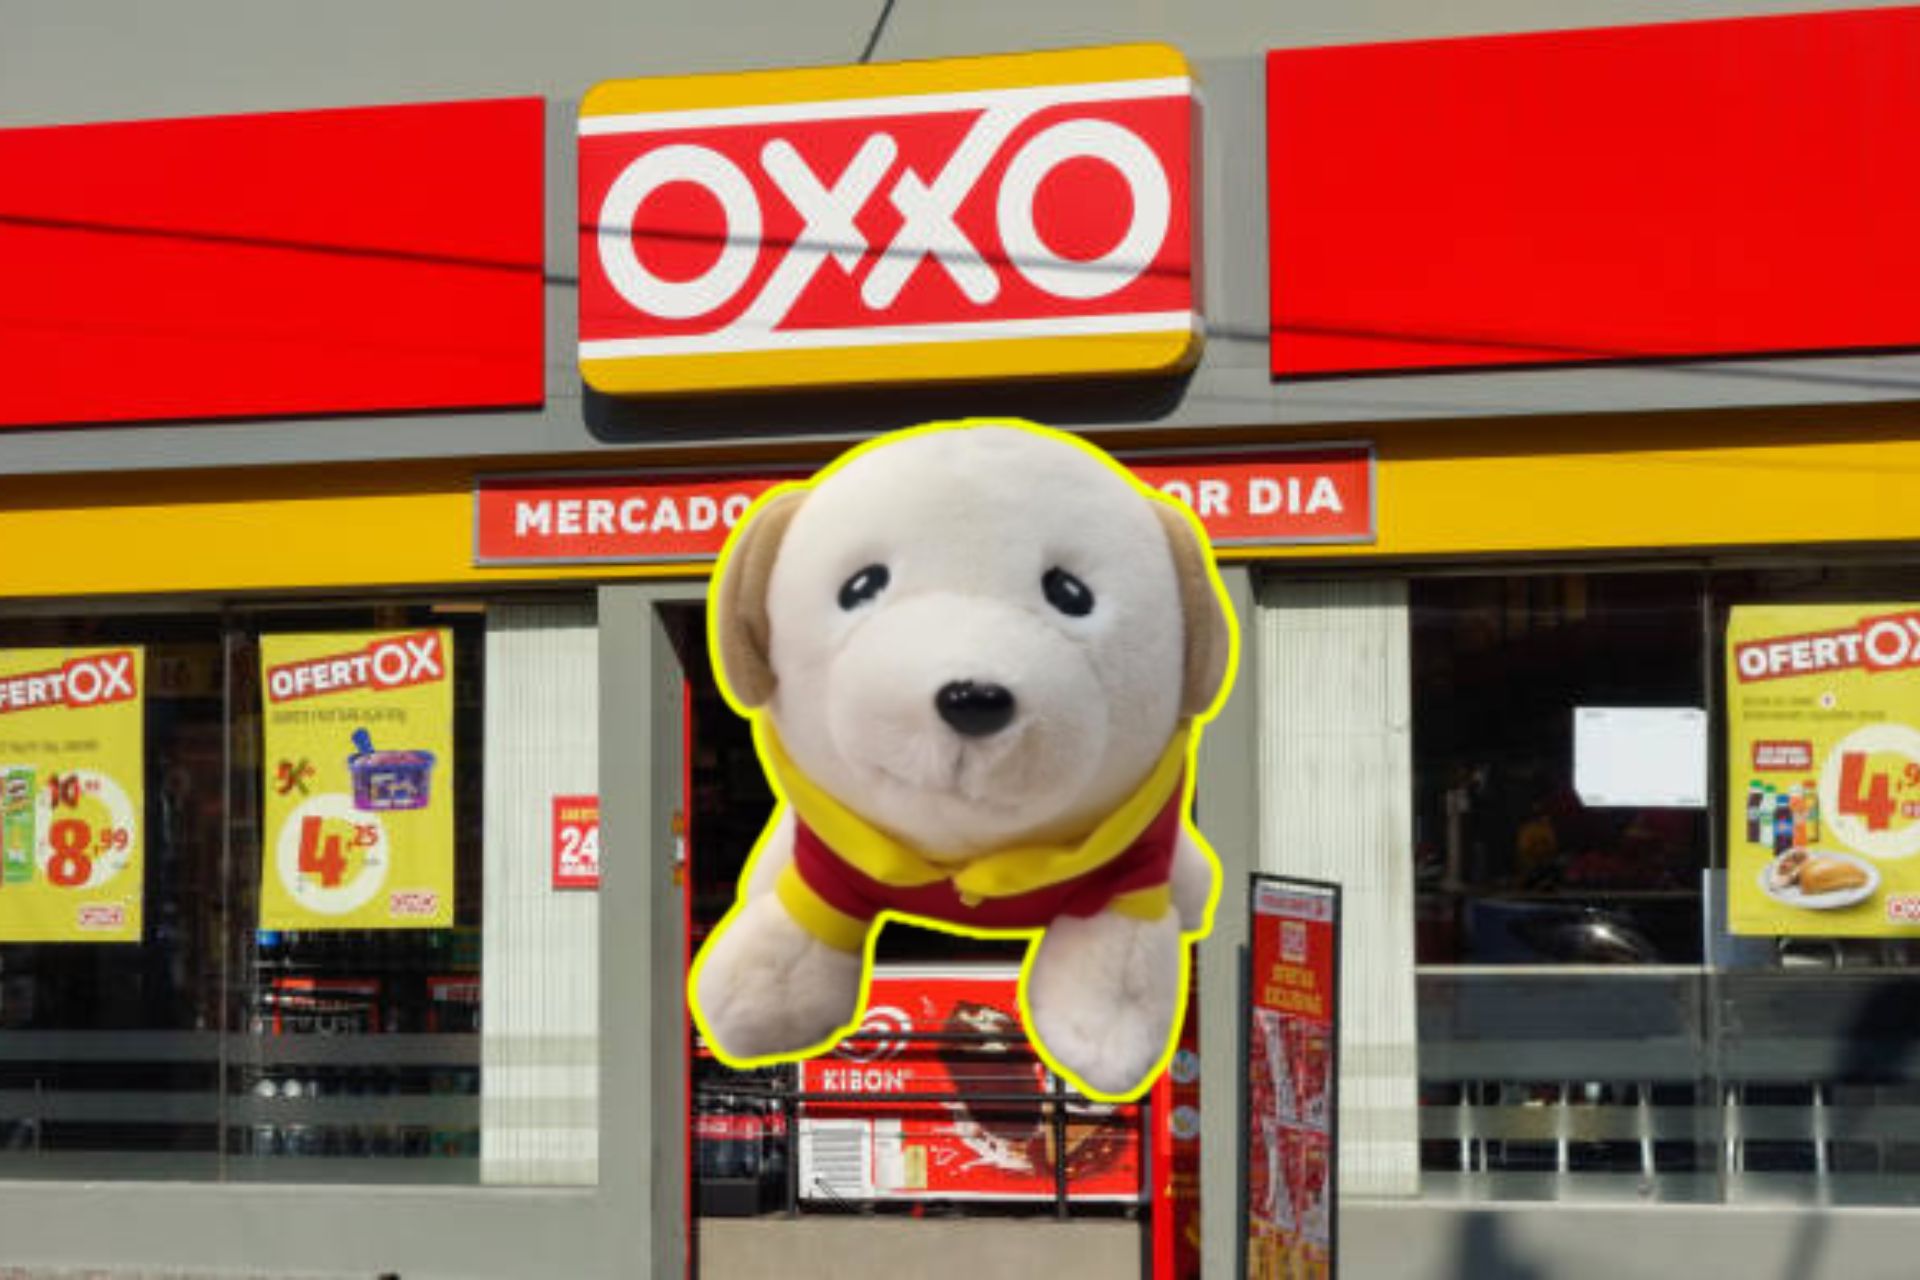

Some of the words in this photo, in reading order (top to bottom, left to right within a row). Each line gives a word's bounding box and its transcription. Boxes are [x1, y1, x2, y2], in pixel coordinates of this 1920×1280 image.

[597, 110, 1171, 325] OXXO
[1248, 475, 1343, 515] DIA
[271, 637, 439, 697] OFERTOX
[823, 1067, 905, 1091] KIBON
